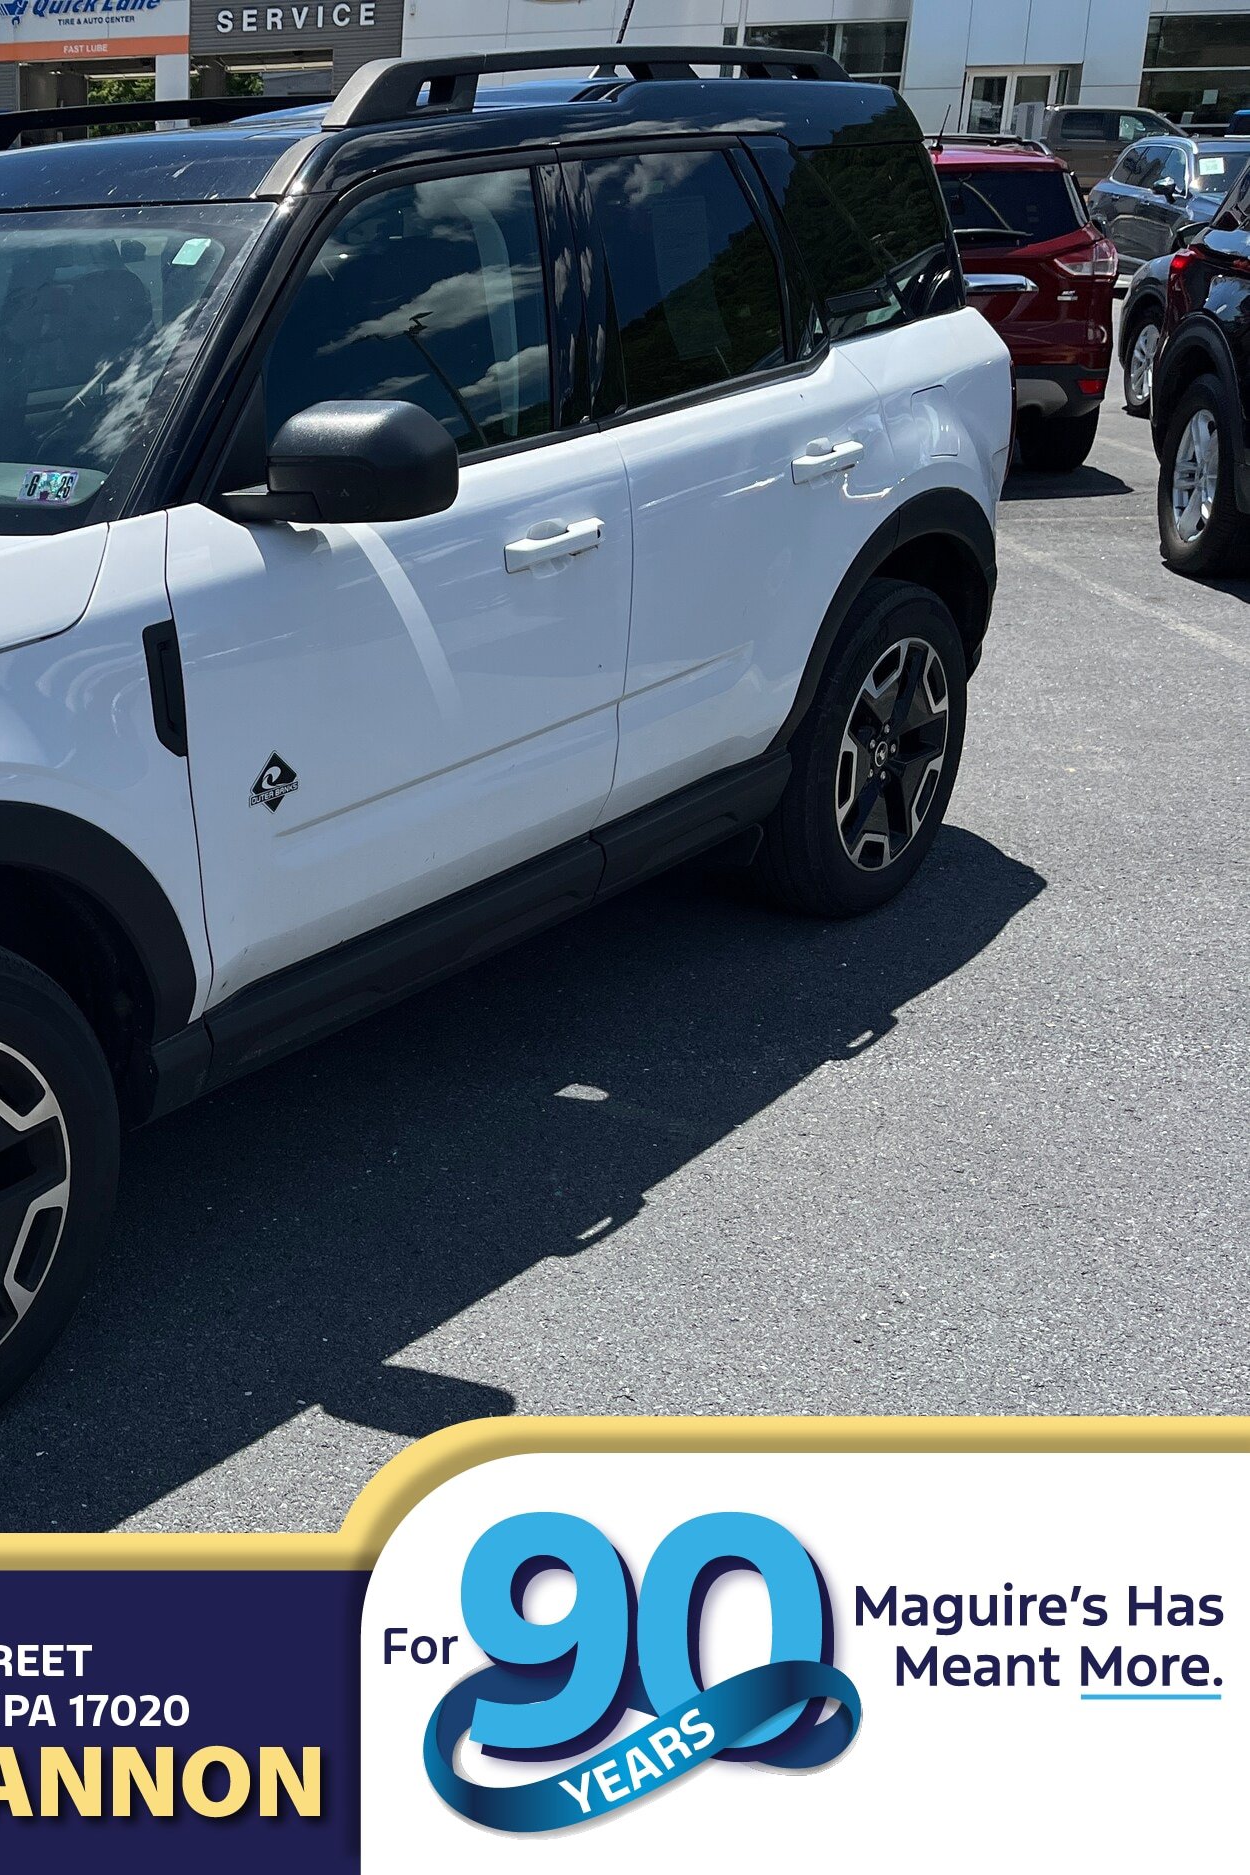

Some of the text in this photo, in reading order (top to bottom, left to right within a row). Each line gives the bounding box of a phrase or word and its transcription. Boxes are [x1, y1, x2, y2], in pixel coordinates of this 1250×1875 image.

[58, 15, 135, 26] TIRE & AUTO CENTER
[216, 3, 375, 33] SERVICE
[63, 44, 108, 54] FAST LUBE
